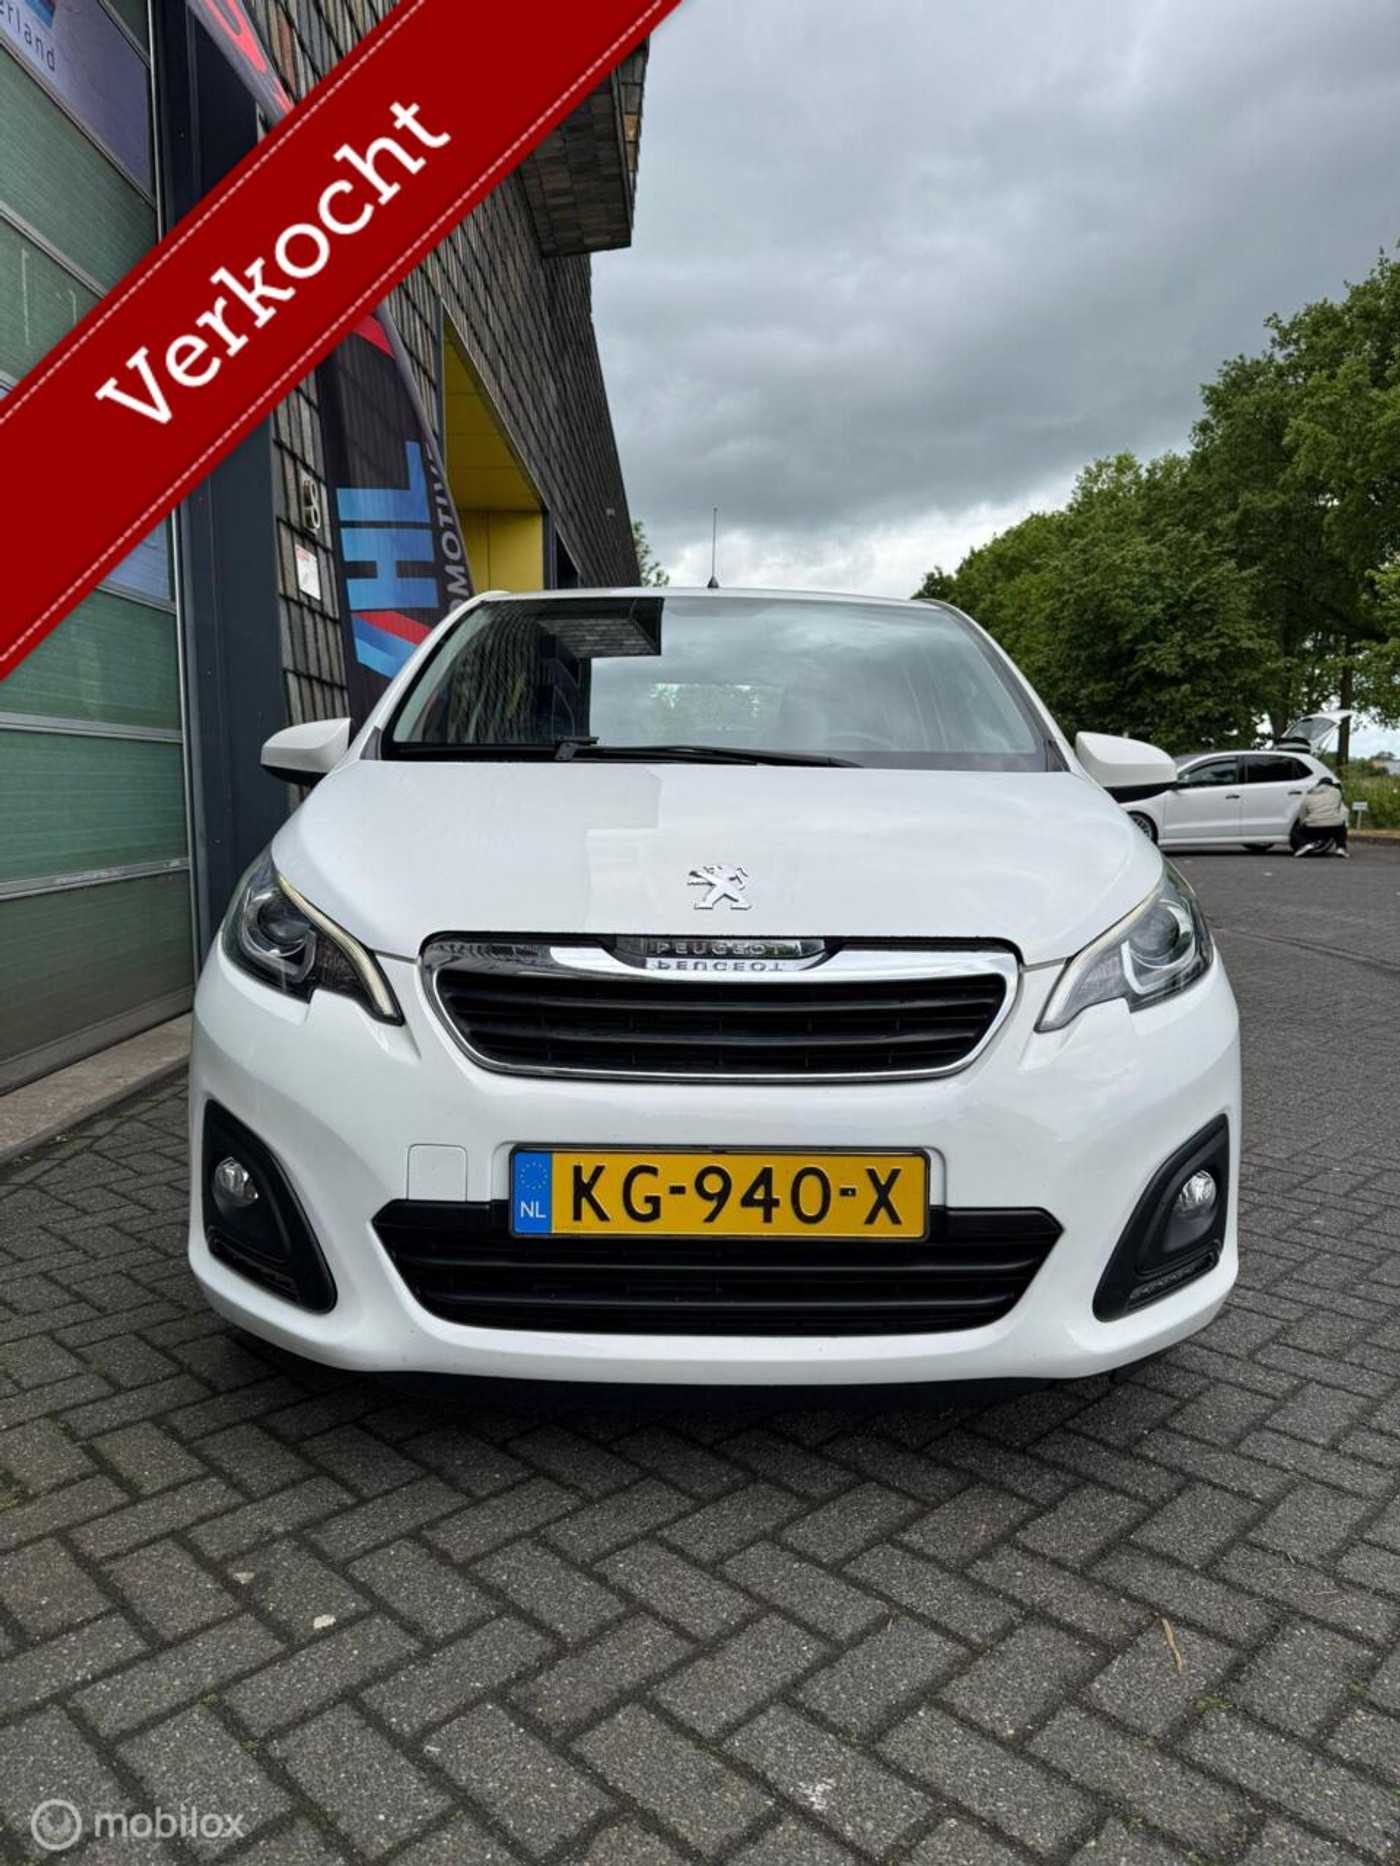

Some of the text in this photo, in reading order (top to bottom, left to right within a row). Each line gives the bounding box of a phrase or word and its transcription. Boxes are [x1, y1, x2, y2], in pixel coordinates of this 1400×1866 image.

[0, 0, 56, 72] rland
[336, 441, 440, 611] HL
[655, 940, 785, 955] PEUGEOT
[520, 1201, 546, 1219] NL
[571, 1163, 904, 1226] KG-940-X
